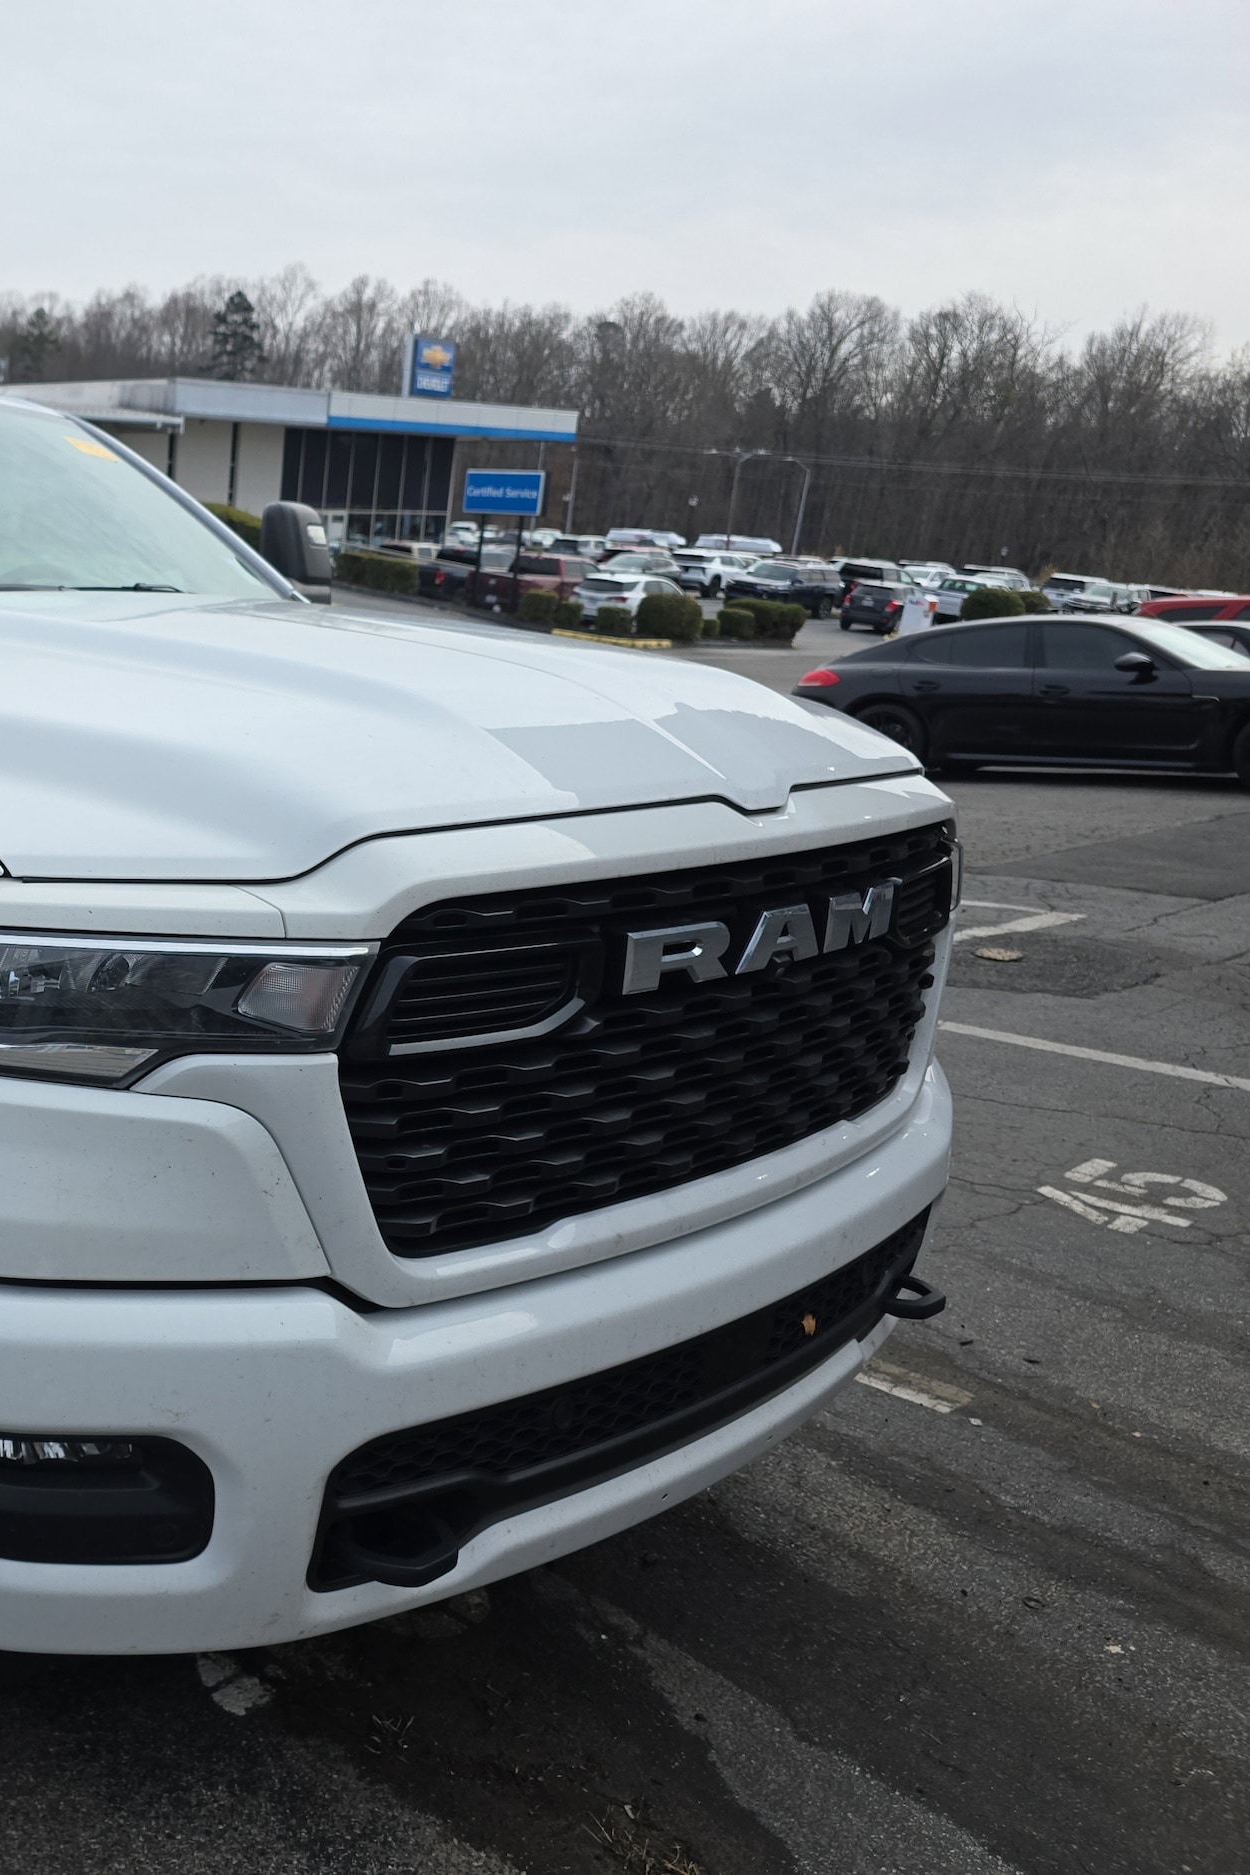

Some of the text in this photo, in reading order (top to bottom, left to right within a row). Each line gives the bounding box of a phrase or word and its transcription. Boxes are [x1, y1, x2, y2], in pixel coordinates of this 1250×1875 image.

[466, 485, 538, 499] Certified Service
[621, 877, 902, 995] RAM
[1036, 1157, 1228, 1235] 45
